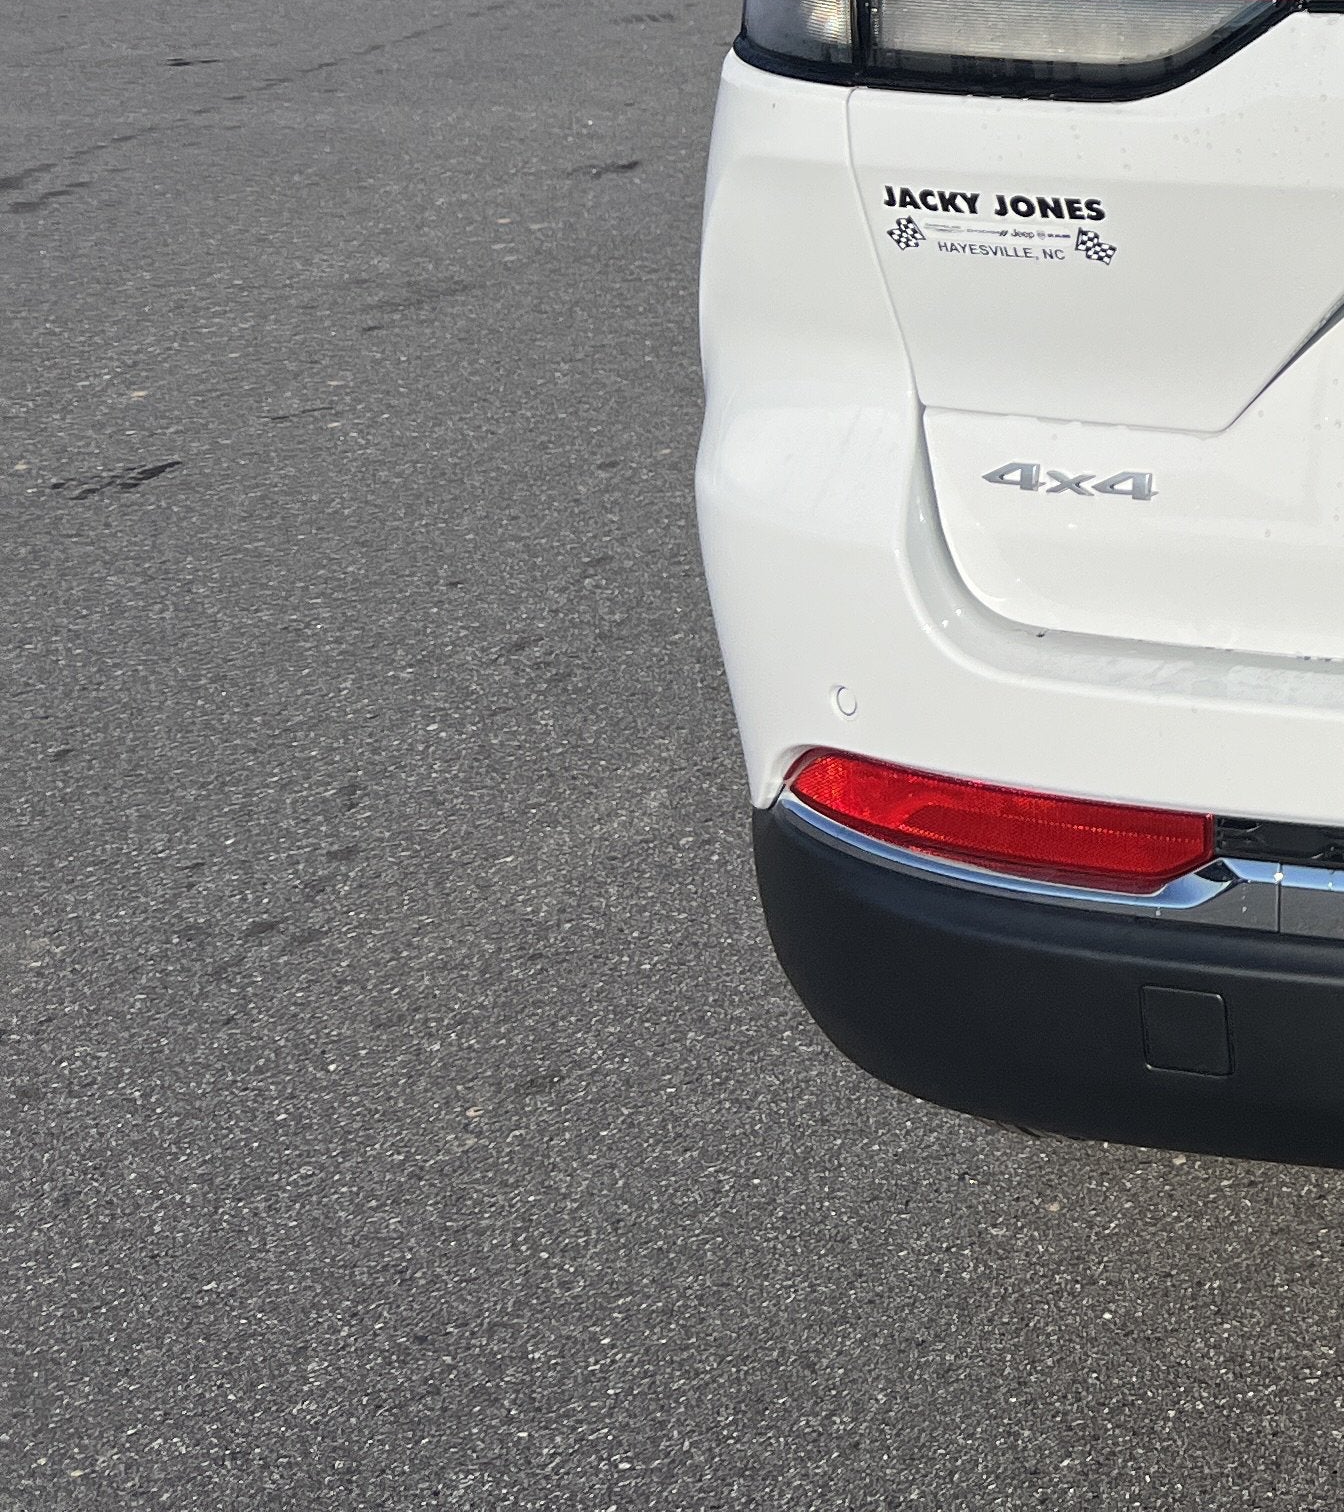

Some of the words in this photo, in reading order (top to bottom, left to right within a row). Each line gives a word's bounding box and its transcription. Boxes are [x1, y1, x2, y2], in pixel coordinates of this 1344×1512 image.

[884, 185, 980, 214] JACKY
[994, 194, 1106, 221] JONES
[937, 241, 1039, 260] HAYESVILLE,
[1042, 249, 1066, 260] NC
[982, 462, 1158, 501] 4x4
